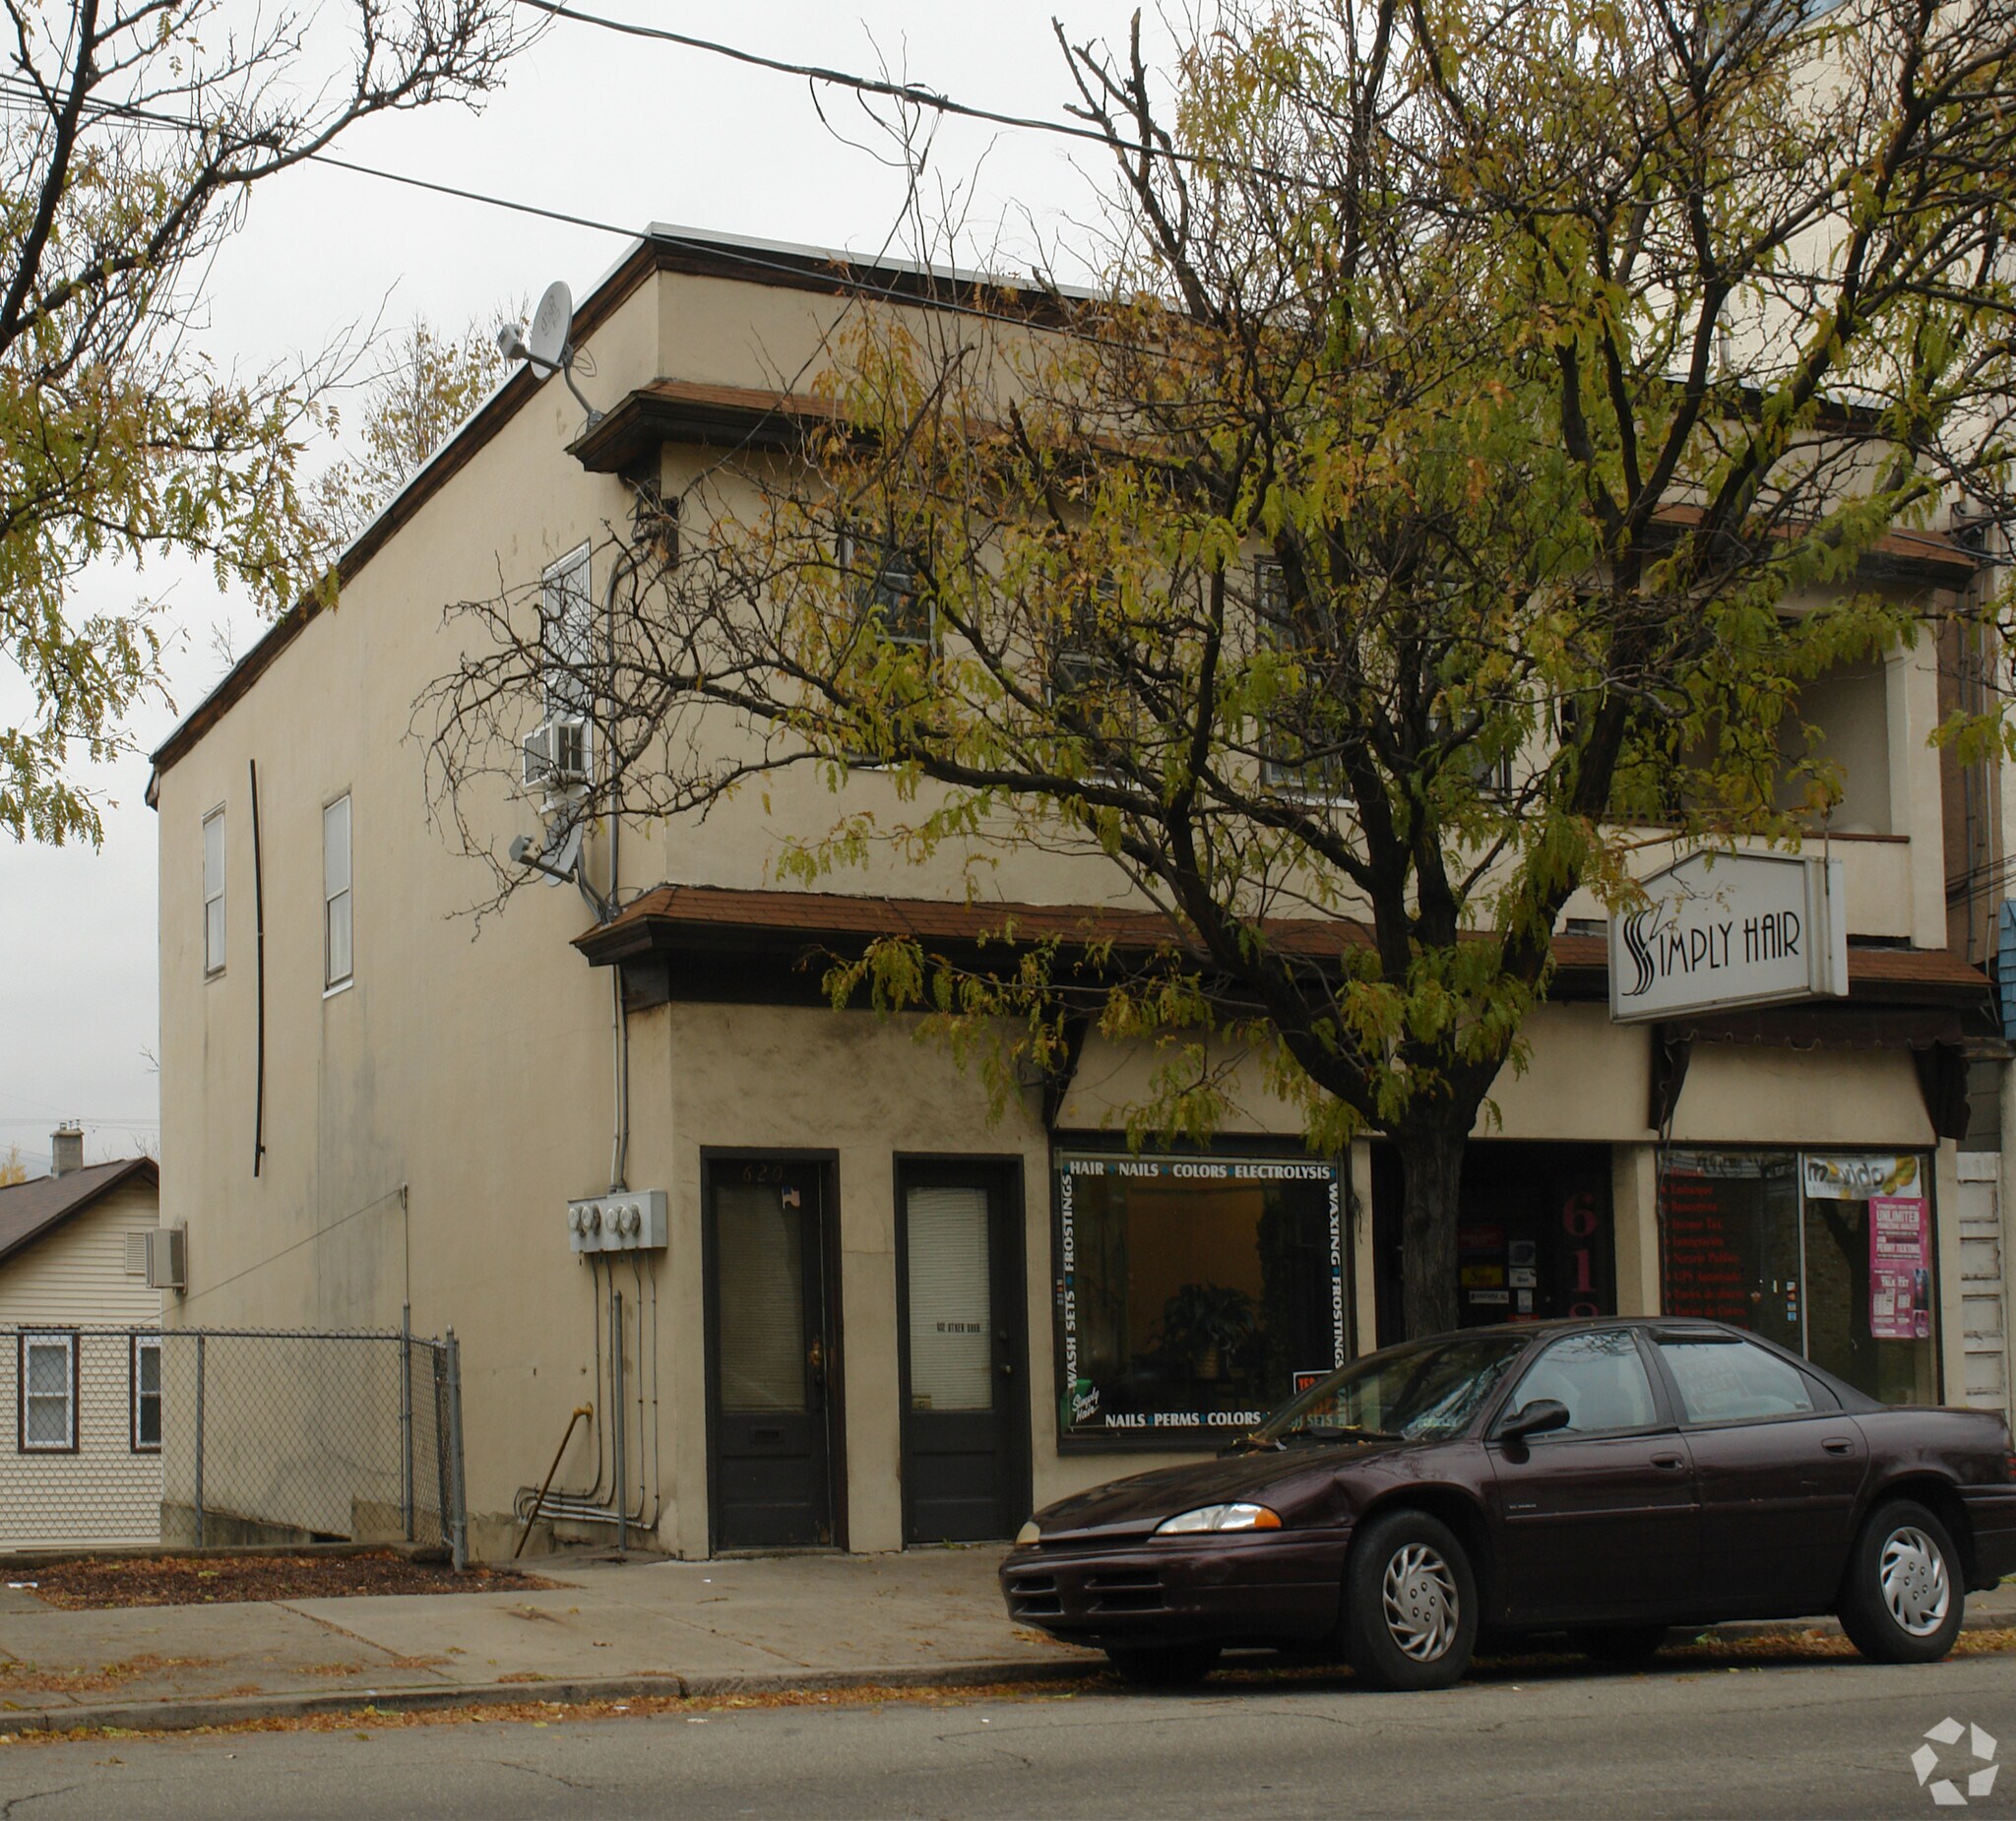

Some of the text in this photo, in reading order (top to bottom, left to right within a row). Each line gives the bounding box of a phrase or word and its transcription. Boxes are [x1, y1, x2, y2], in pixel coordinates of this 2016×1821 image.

[1621, 909, 1800, 996] SIMPLY HAIR
[742, 1164, 784, 1182] 620
[1070, 1161, 1330, 1180] HAIR NAILS COLORS ELECTROLYSIS
[1807, 1162, 1884, 1187] mvida
[1876, 1210, 1920, 1223] UNLIMITED
[1063, 1175, 1078, 1389] WASH SETS FROSTINGS
[1329, 1182, 1345, 1369] WAXING FROSTINGS
[1105, 1412, 1261, 1427] NAILS PERMS COLORS
